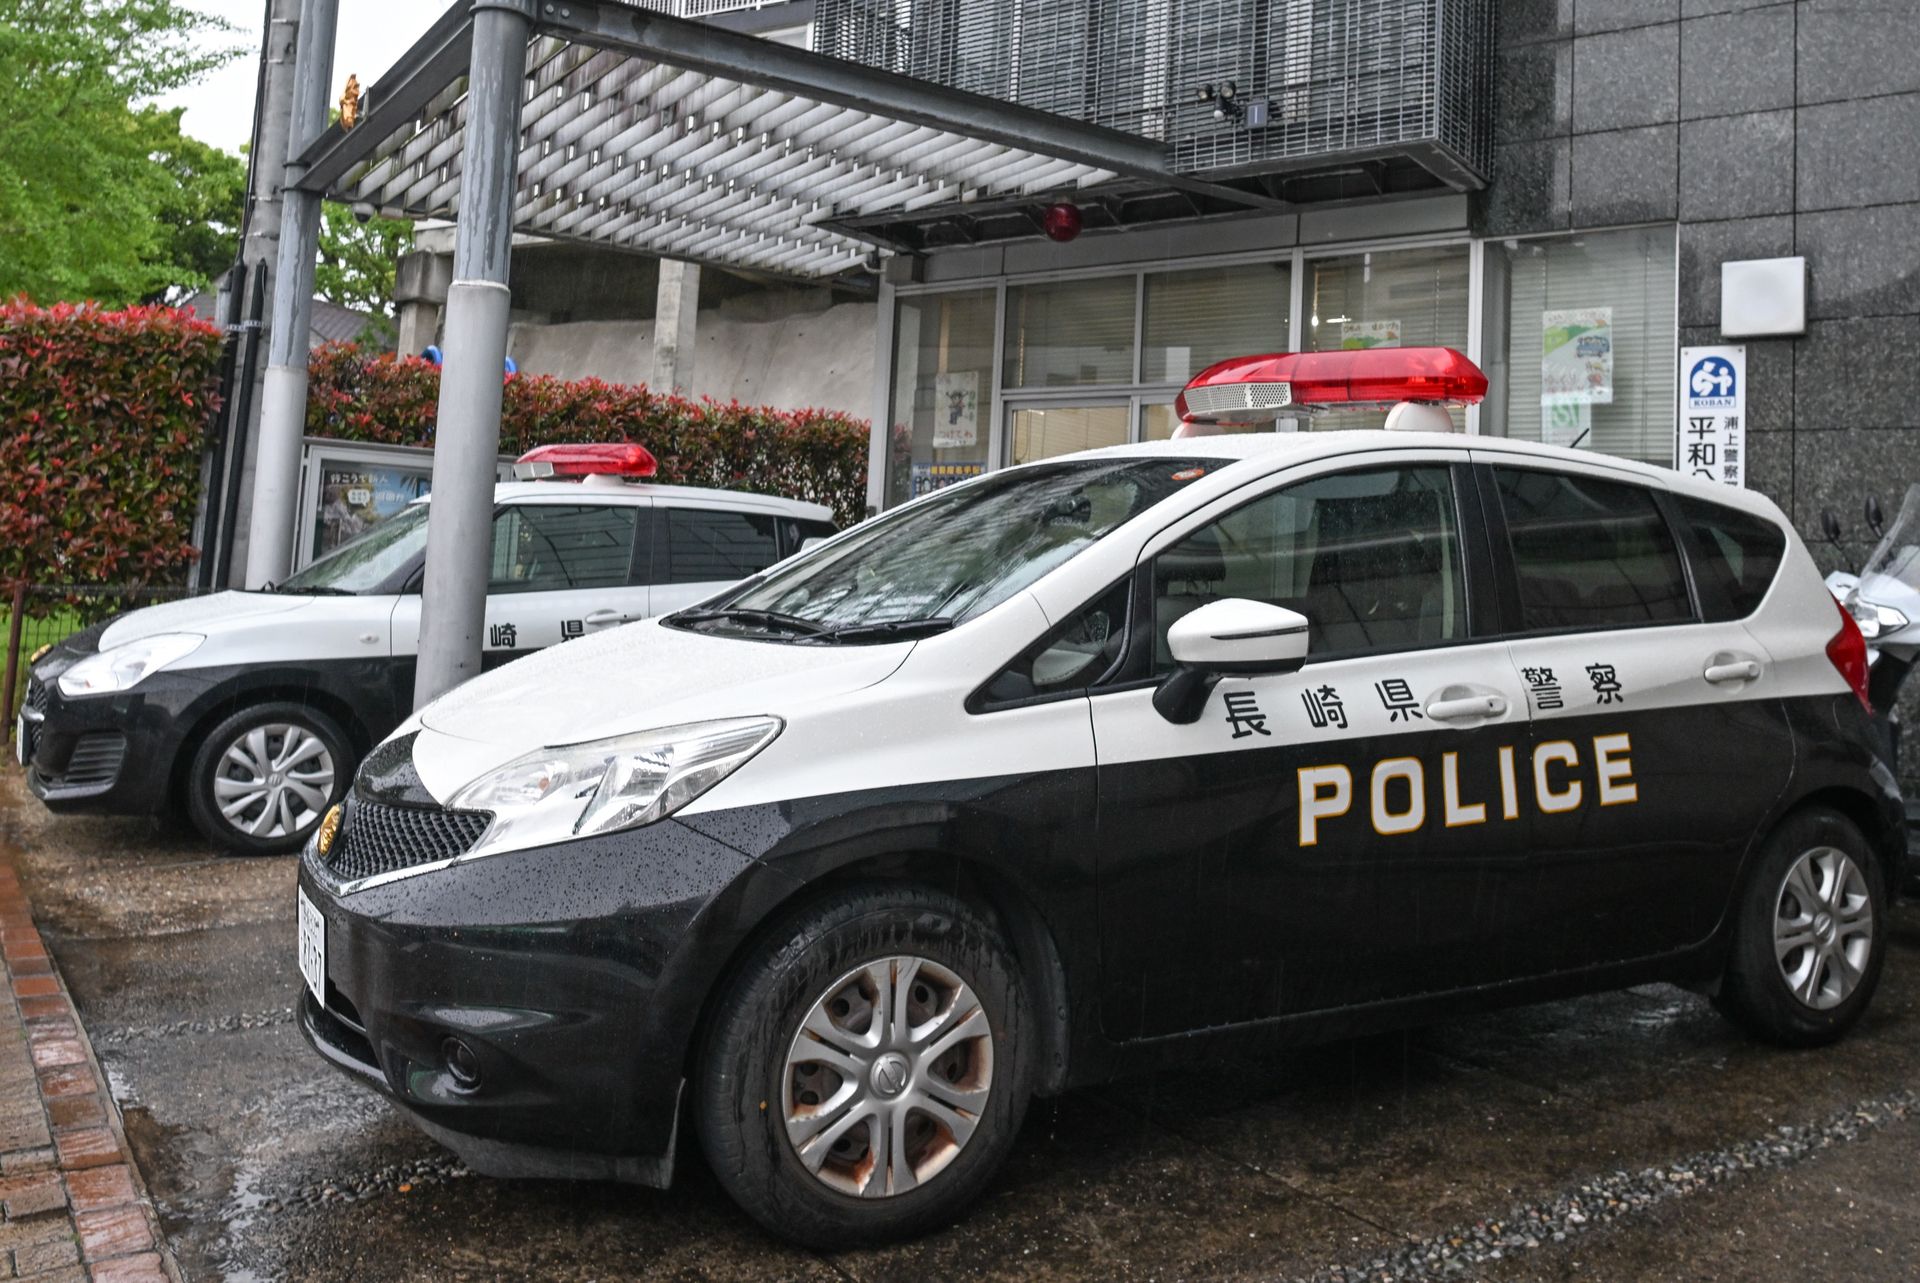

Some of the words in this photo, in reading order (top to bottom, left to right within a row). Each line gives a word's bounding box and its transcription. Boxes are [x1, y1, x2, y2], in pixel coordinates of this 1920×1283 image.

[1694, 399, 1732, 407] KOBAN
[1723, 416, 1739, 486] 浦上警察
[1222, 678, 1425, 739] 長崎県
[1521, 662, 1625, 711] 警察
[1297, 732, 1638, 846] POLICE
